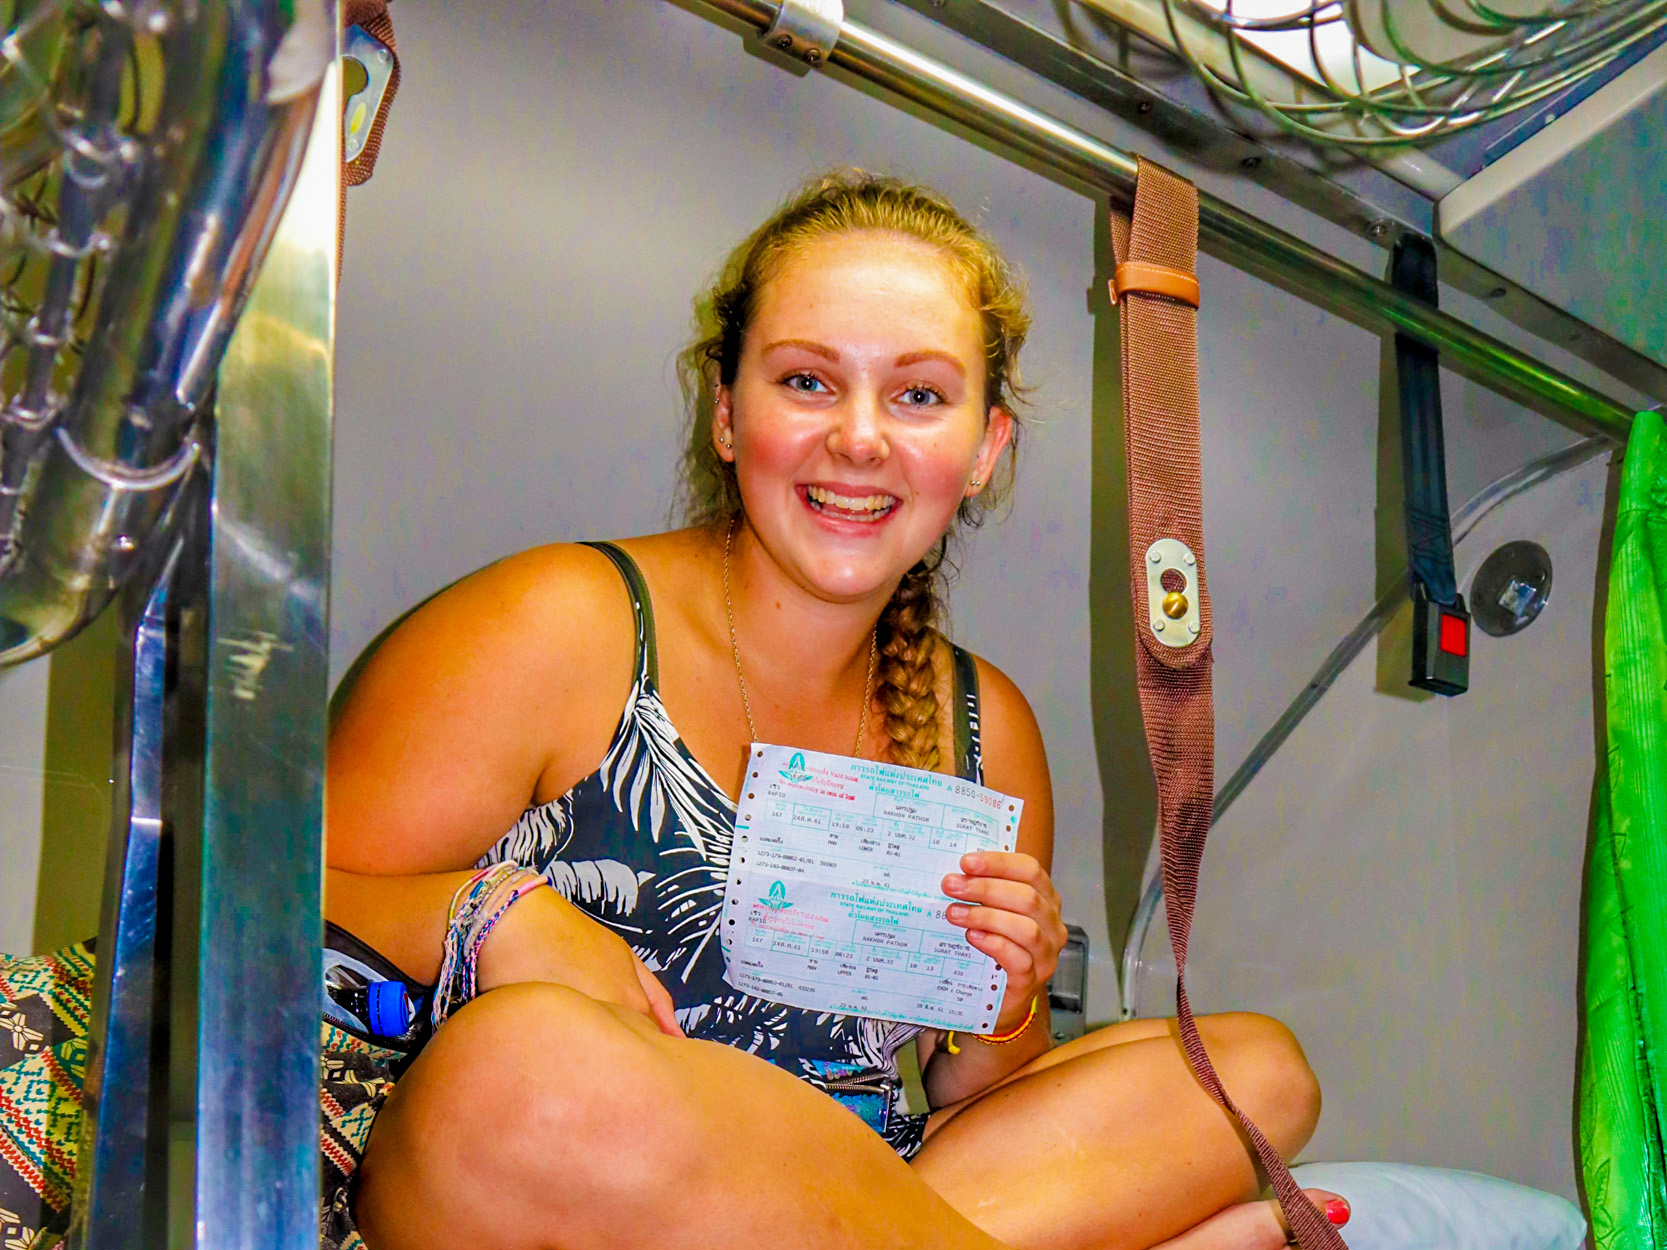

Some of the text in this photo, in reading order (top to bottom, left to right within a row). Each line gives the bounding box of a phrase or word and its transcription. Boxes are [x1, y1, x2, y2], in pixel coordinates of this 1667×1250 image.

[851, 763, 943, 787] การรถไฟแห่งประเทศไทย
[906, 781, 929, 790] THAILAND
[955, 785, 1001, 810] 8850-59086
[831, 892, 922, 913] การรถไฟแห่งประเทศไทย
